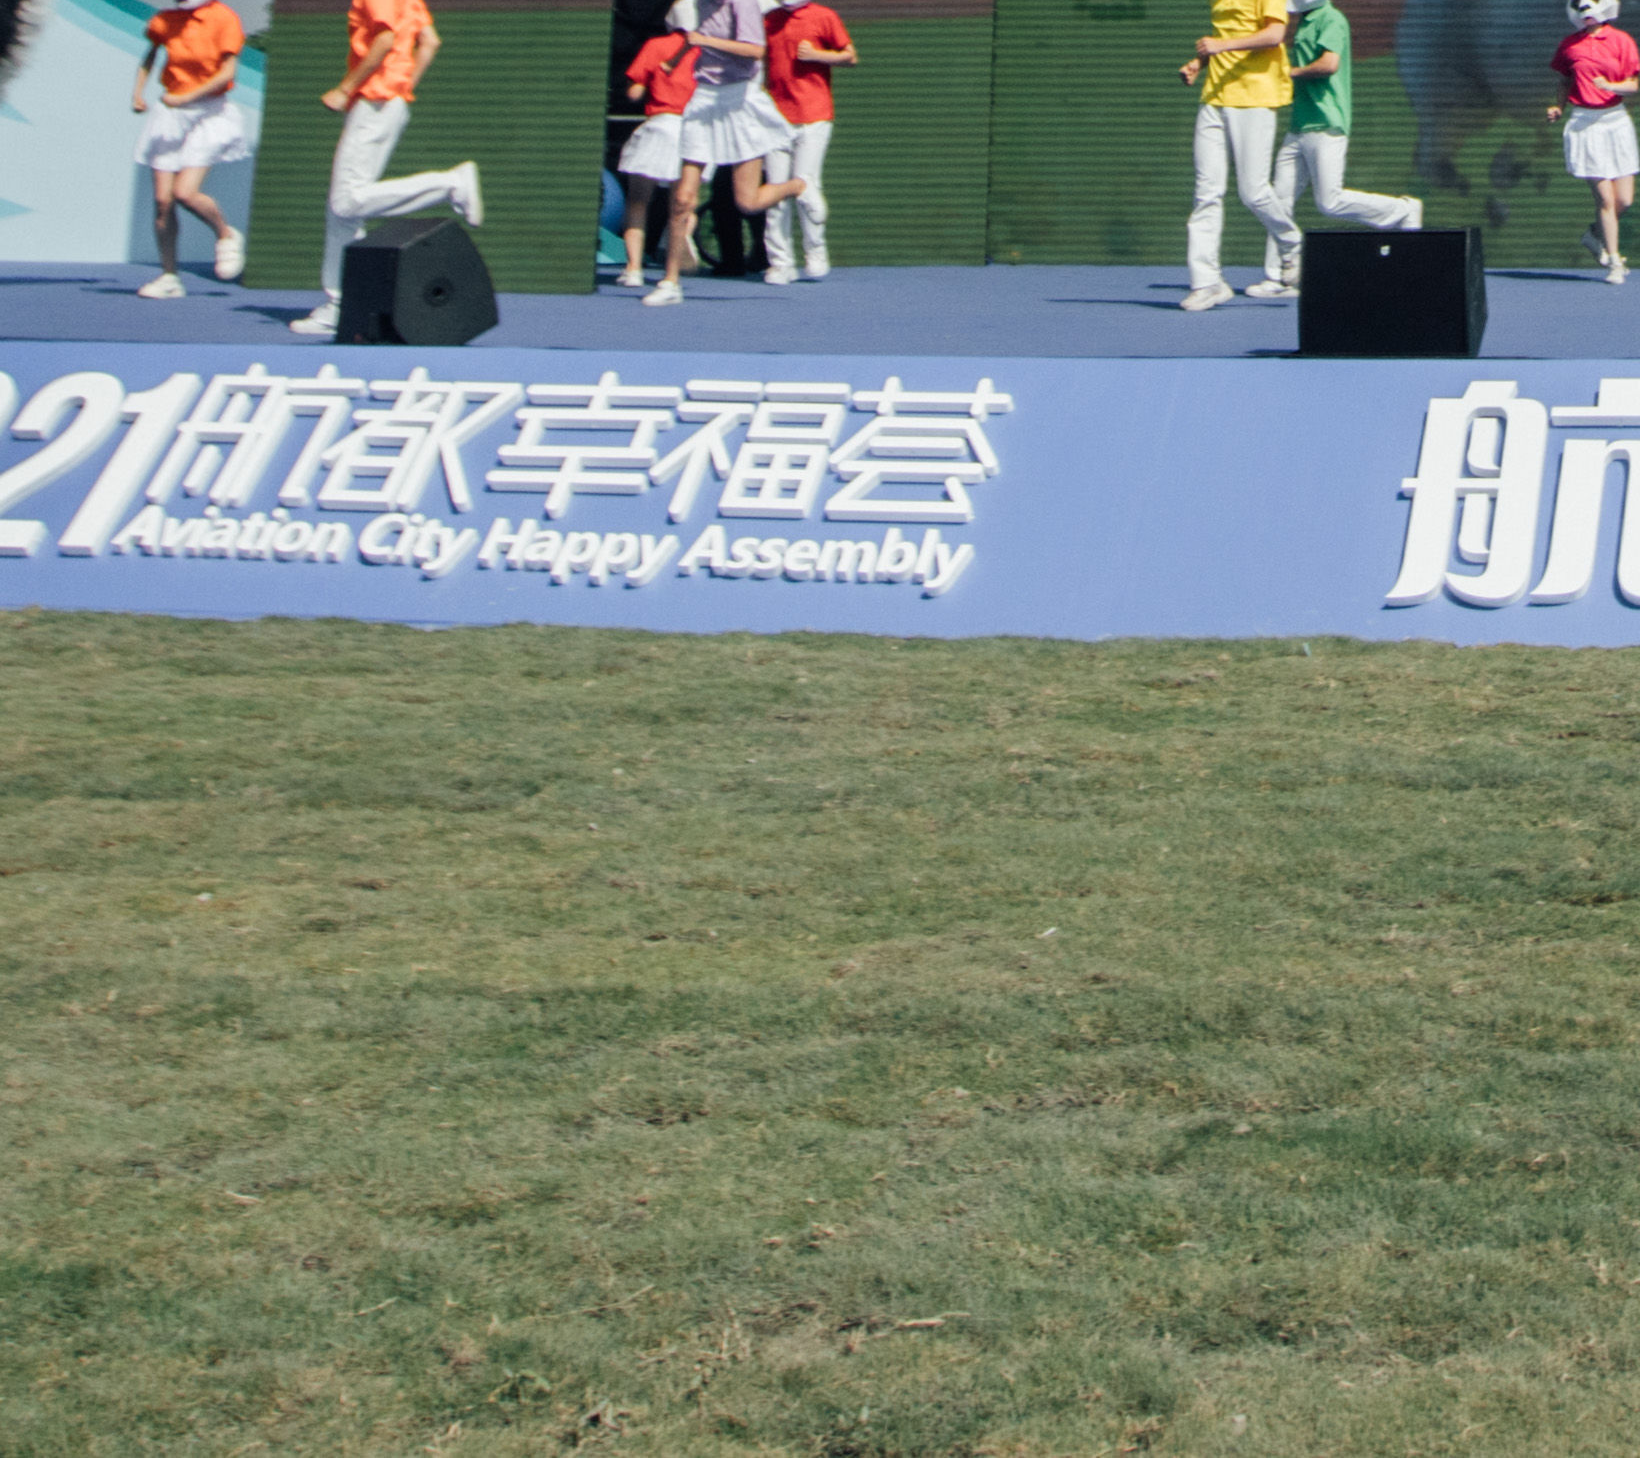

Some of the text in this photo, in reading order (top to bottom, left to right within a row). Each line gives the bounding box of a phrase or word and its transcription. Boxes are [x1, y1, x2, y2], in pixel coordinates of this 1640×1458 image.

[111, 504, 975, 598] Aviation City Happy Assembly
